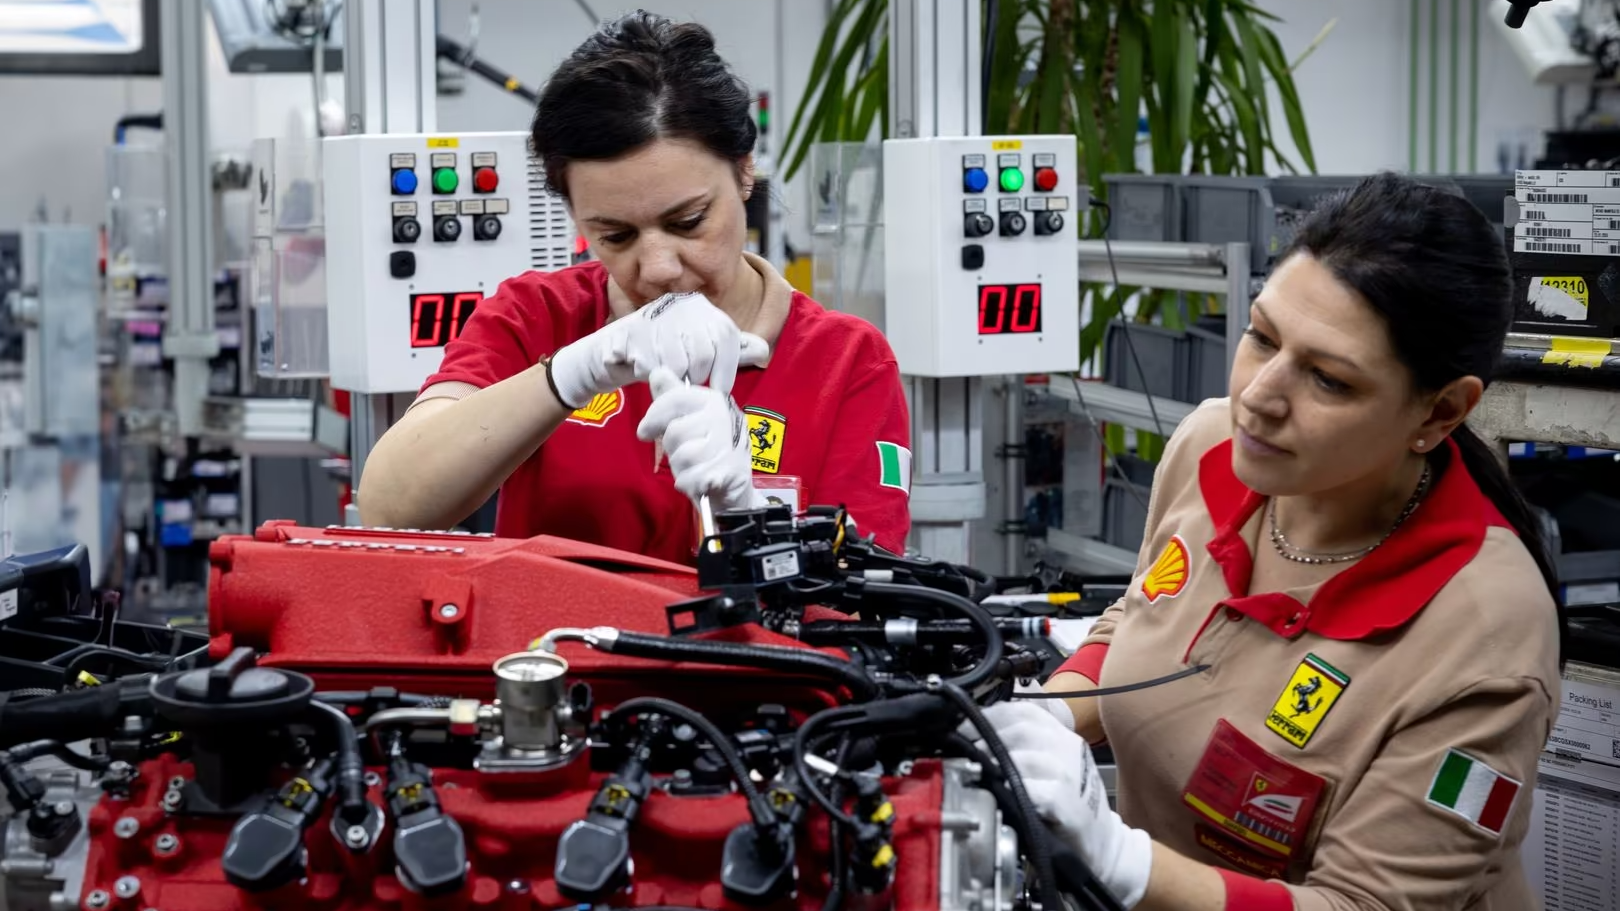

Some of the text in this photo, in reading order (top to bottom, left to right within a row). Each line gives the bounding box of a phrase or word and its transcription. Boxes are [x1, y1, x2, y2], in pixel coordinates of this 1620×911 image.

[978, 284, 1041, 333] 00
[1569, 692, 1613, 709] Packing List
[1267, 710, 1309, 741] Ferrari
